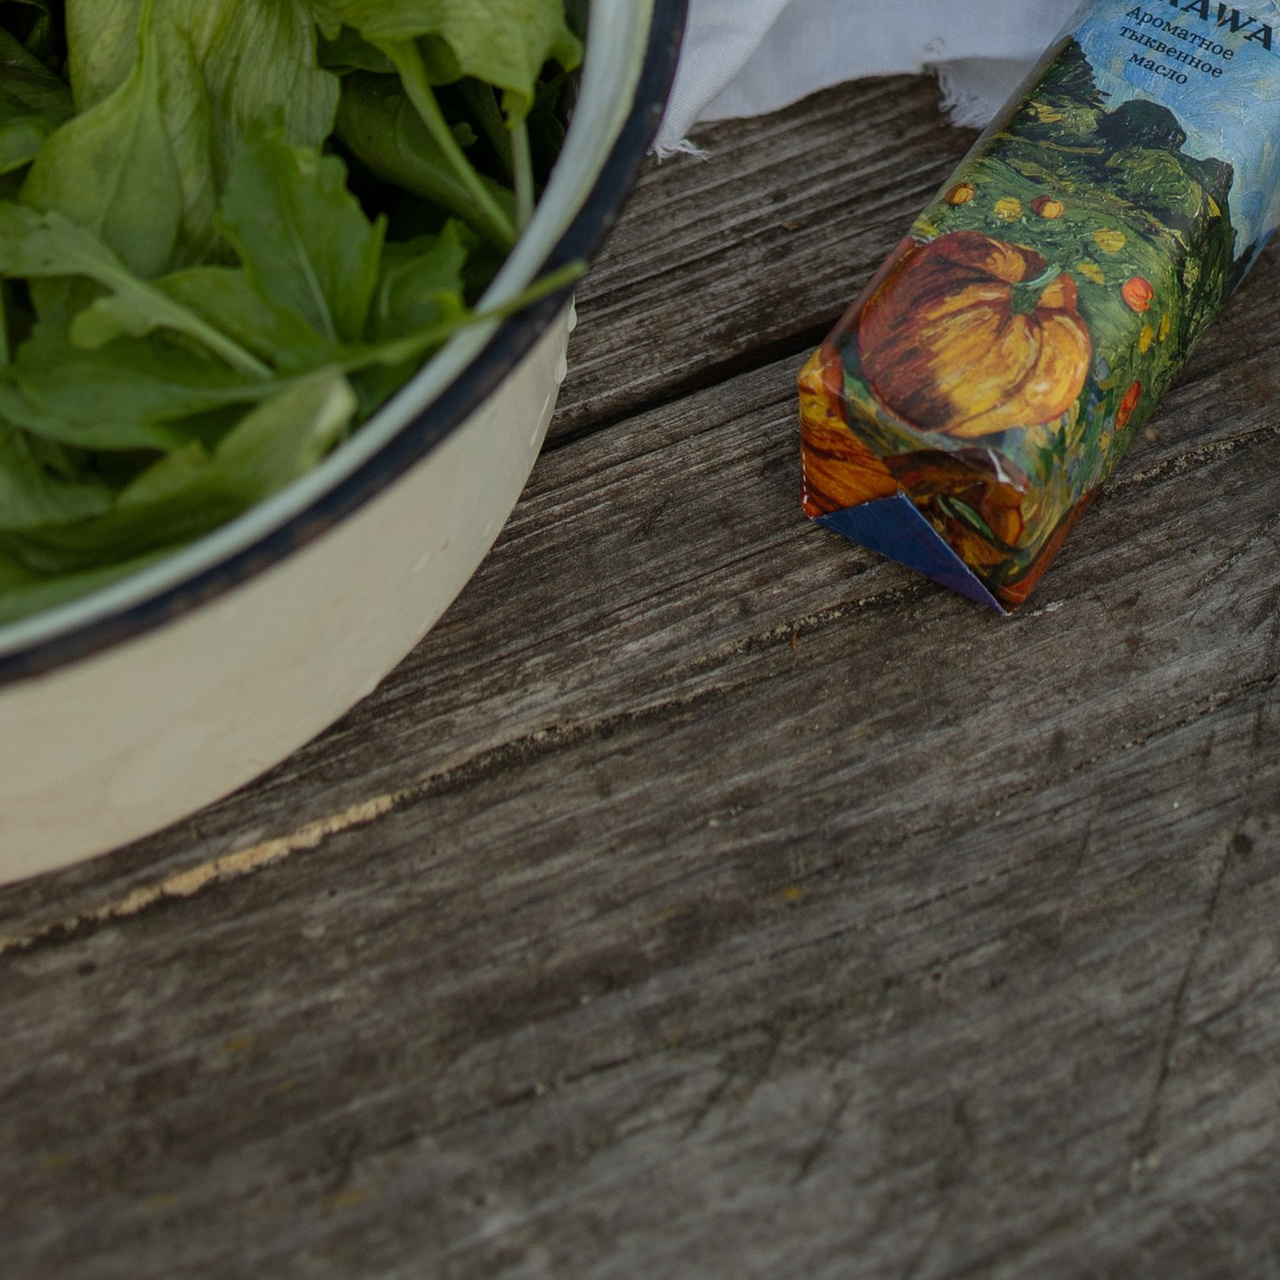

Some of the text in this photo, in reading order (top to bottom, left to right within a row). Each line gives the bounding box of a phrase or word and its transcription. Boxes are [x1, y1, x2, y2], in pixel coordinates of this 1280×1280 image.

[1119, 26, 1223, 78] тыквенное
[1125, 6, 1235, 61] Ароматное
[1128, 52, 1188, 85] масло
